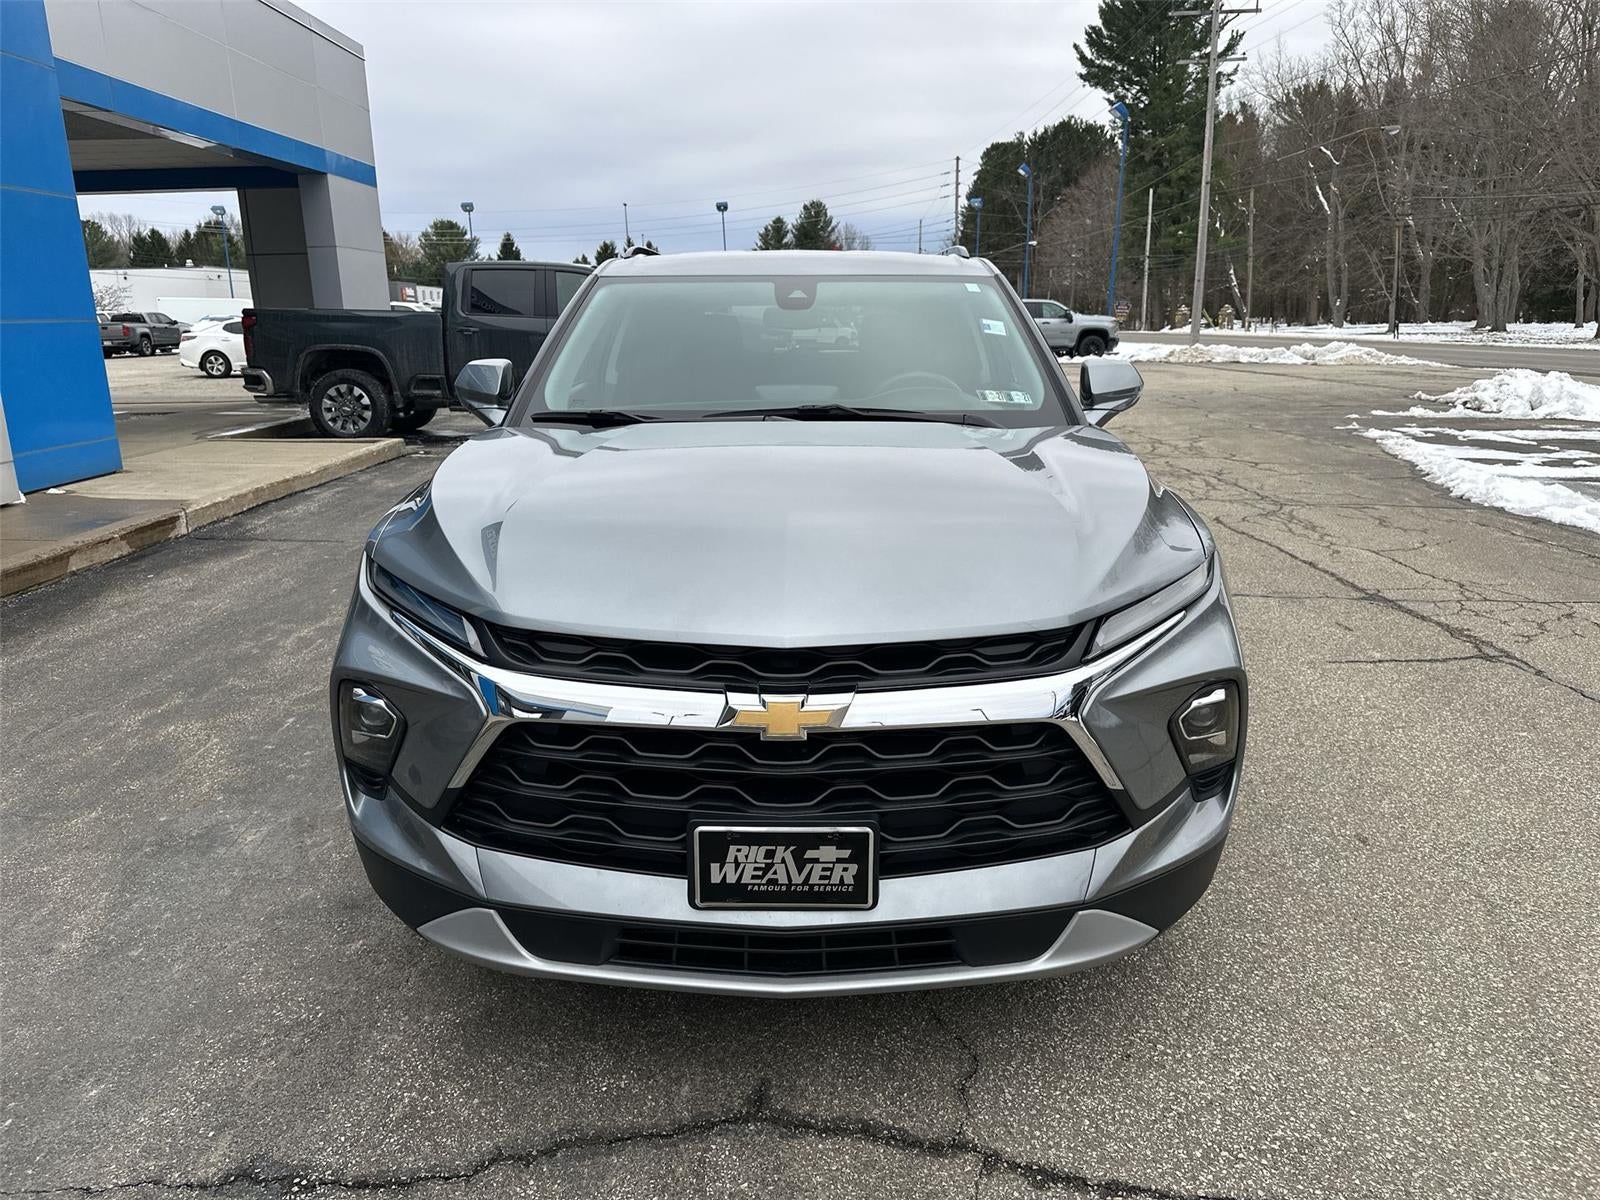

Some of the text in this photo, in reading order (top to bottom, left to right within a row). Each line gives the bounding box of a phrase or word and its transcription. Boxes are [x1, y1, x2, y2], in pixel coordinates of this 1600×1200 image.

[726, 845, 798, 863] RICK
[710, 862, 858, 884] WEAVER
[747, 884, 854, 892] FAMOUS FOR SERVICE
